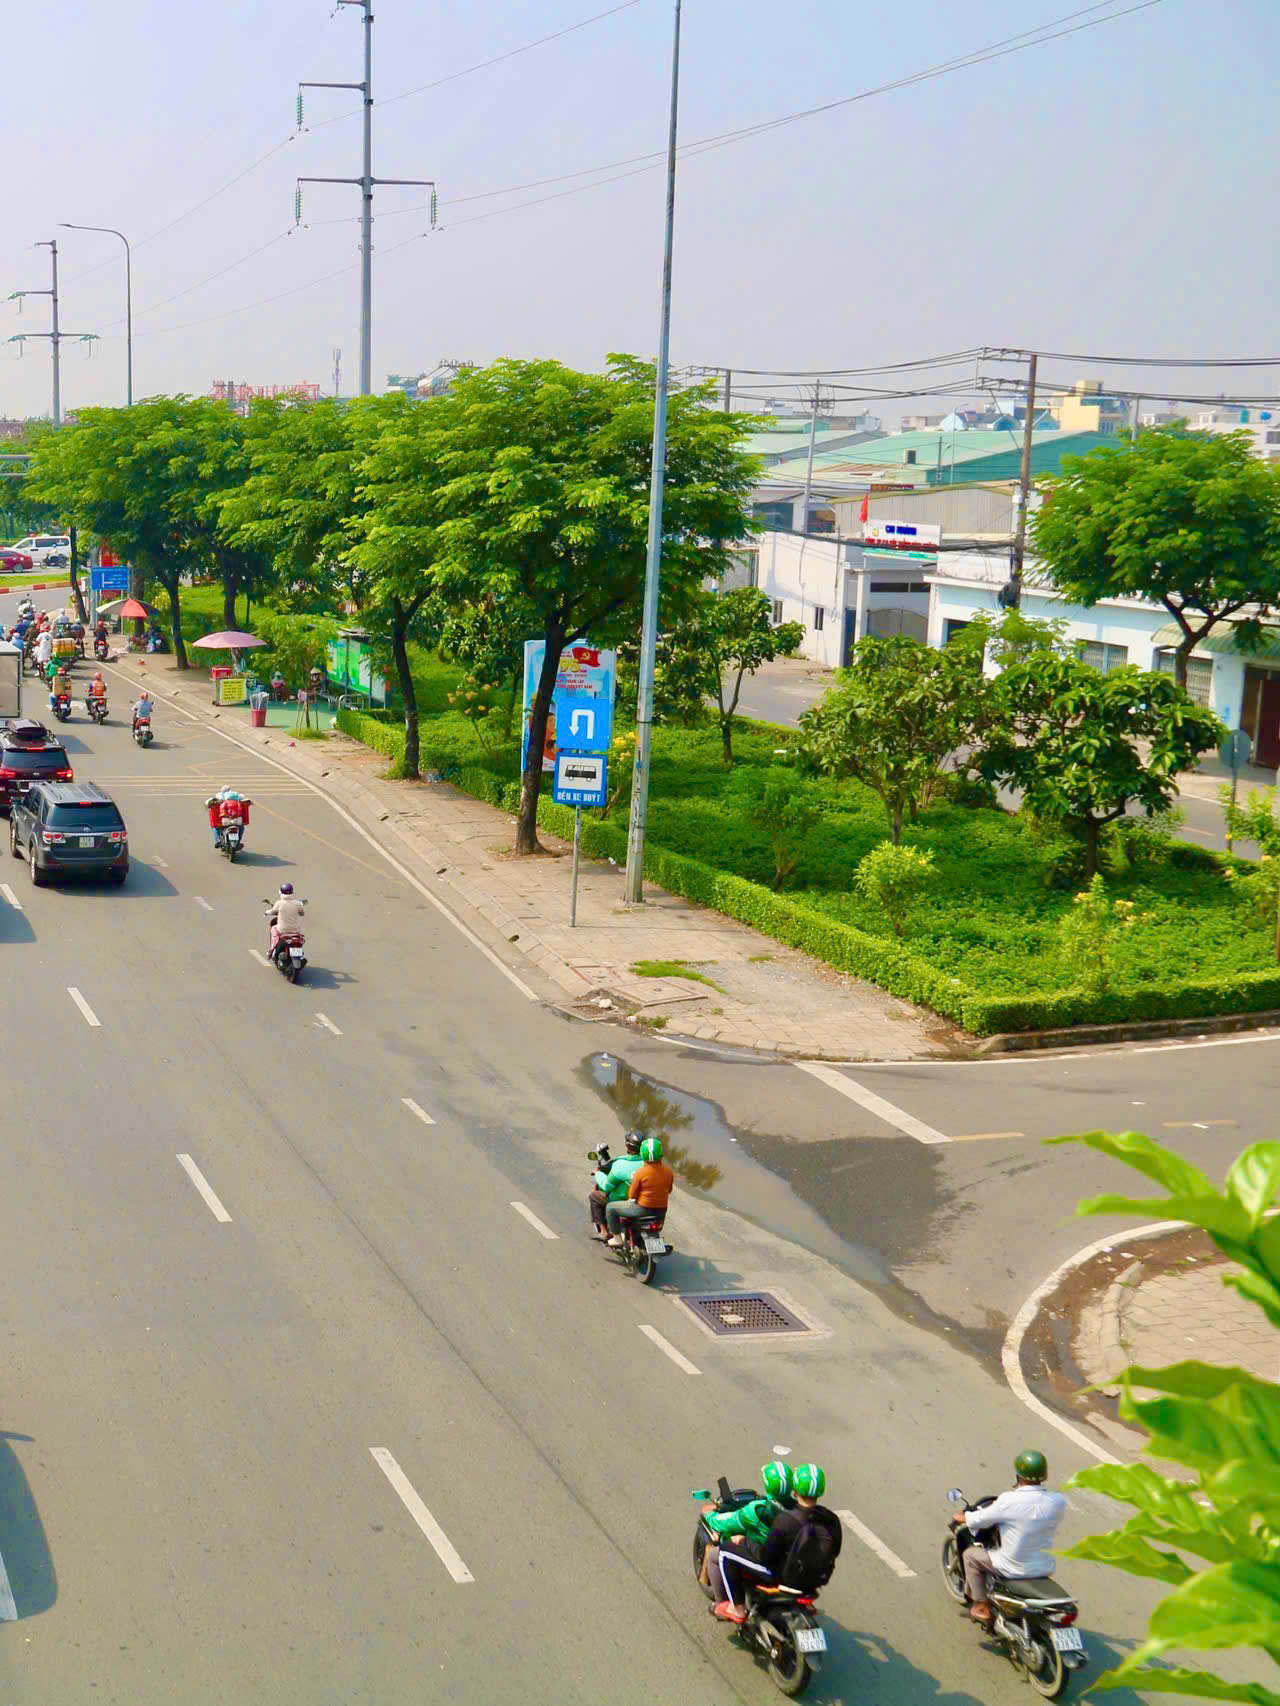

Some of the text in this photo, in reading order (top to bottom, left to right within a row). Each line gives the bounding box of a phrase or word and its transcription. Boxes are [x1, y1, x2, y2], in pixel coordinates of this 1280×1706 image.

[557, 789, 601, 803] BẾN XE BUÝT
